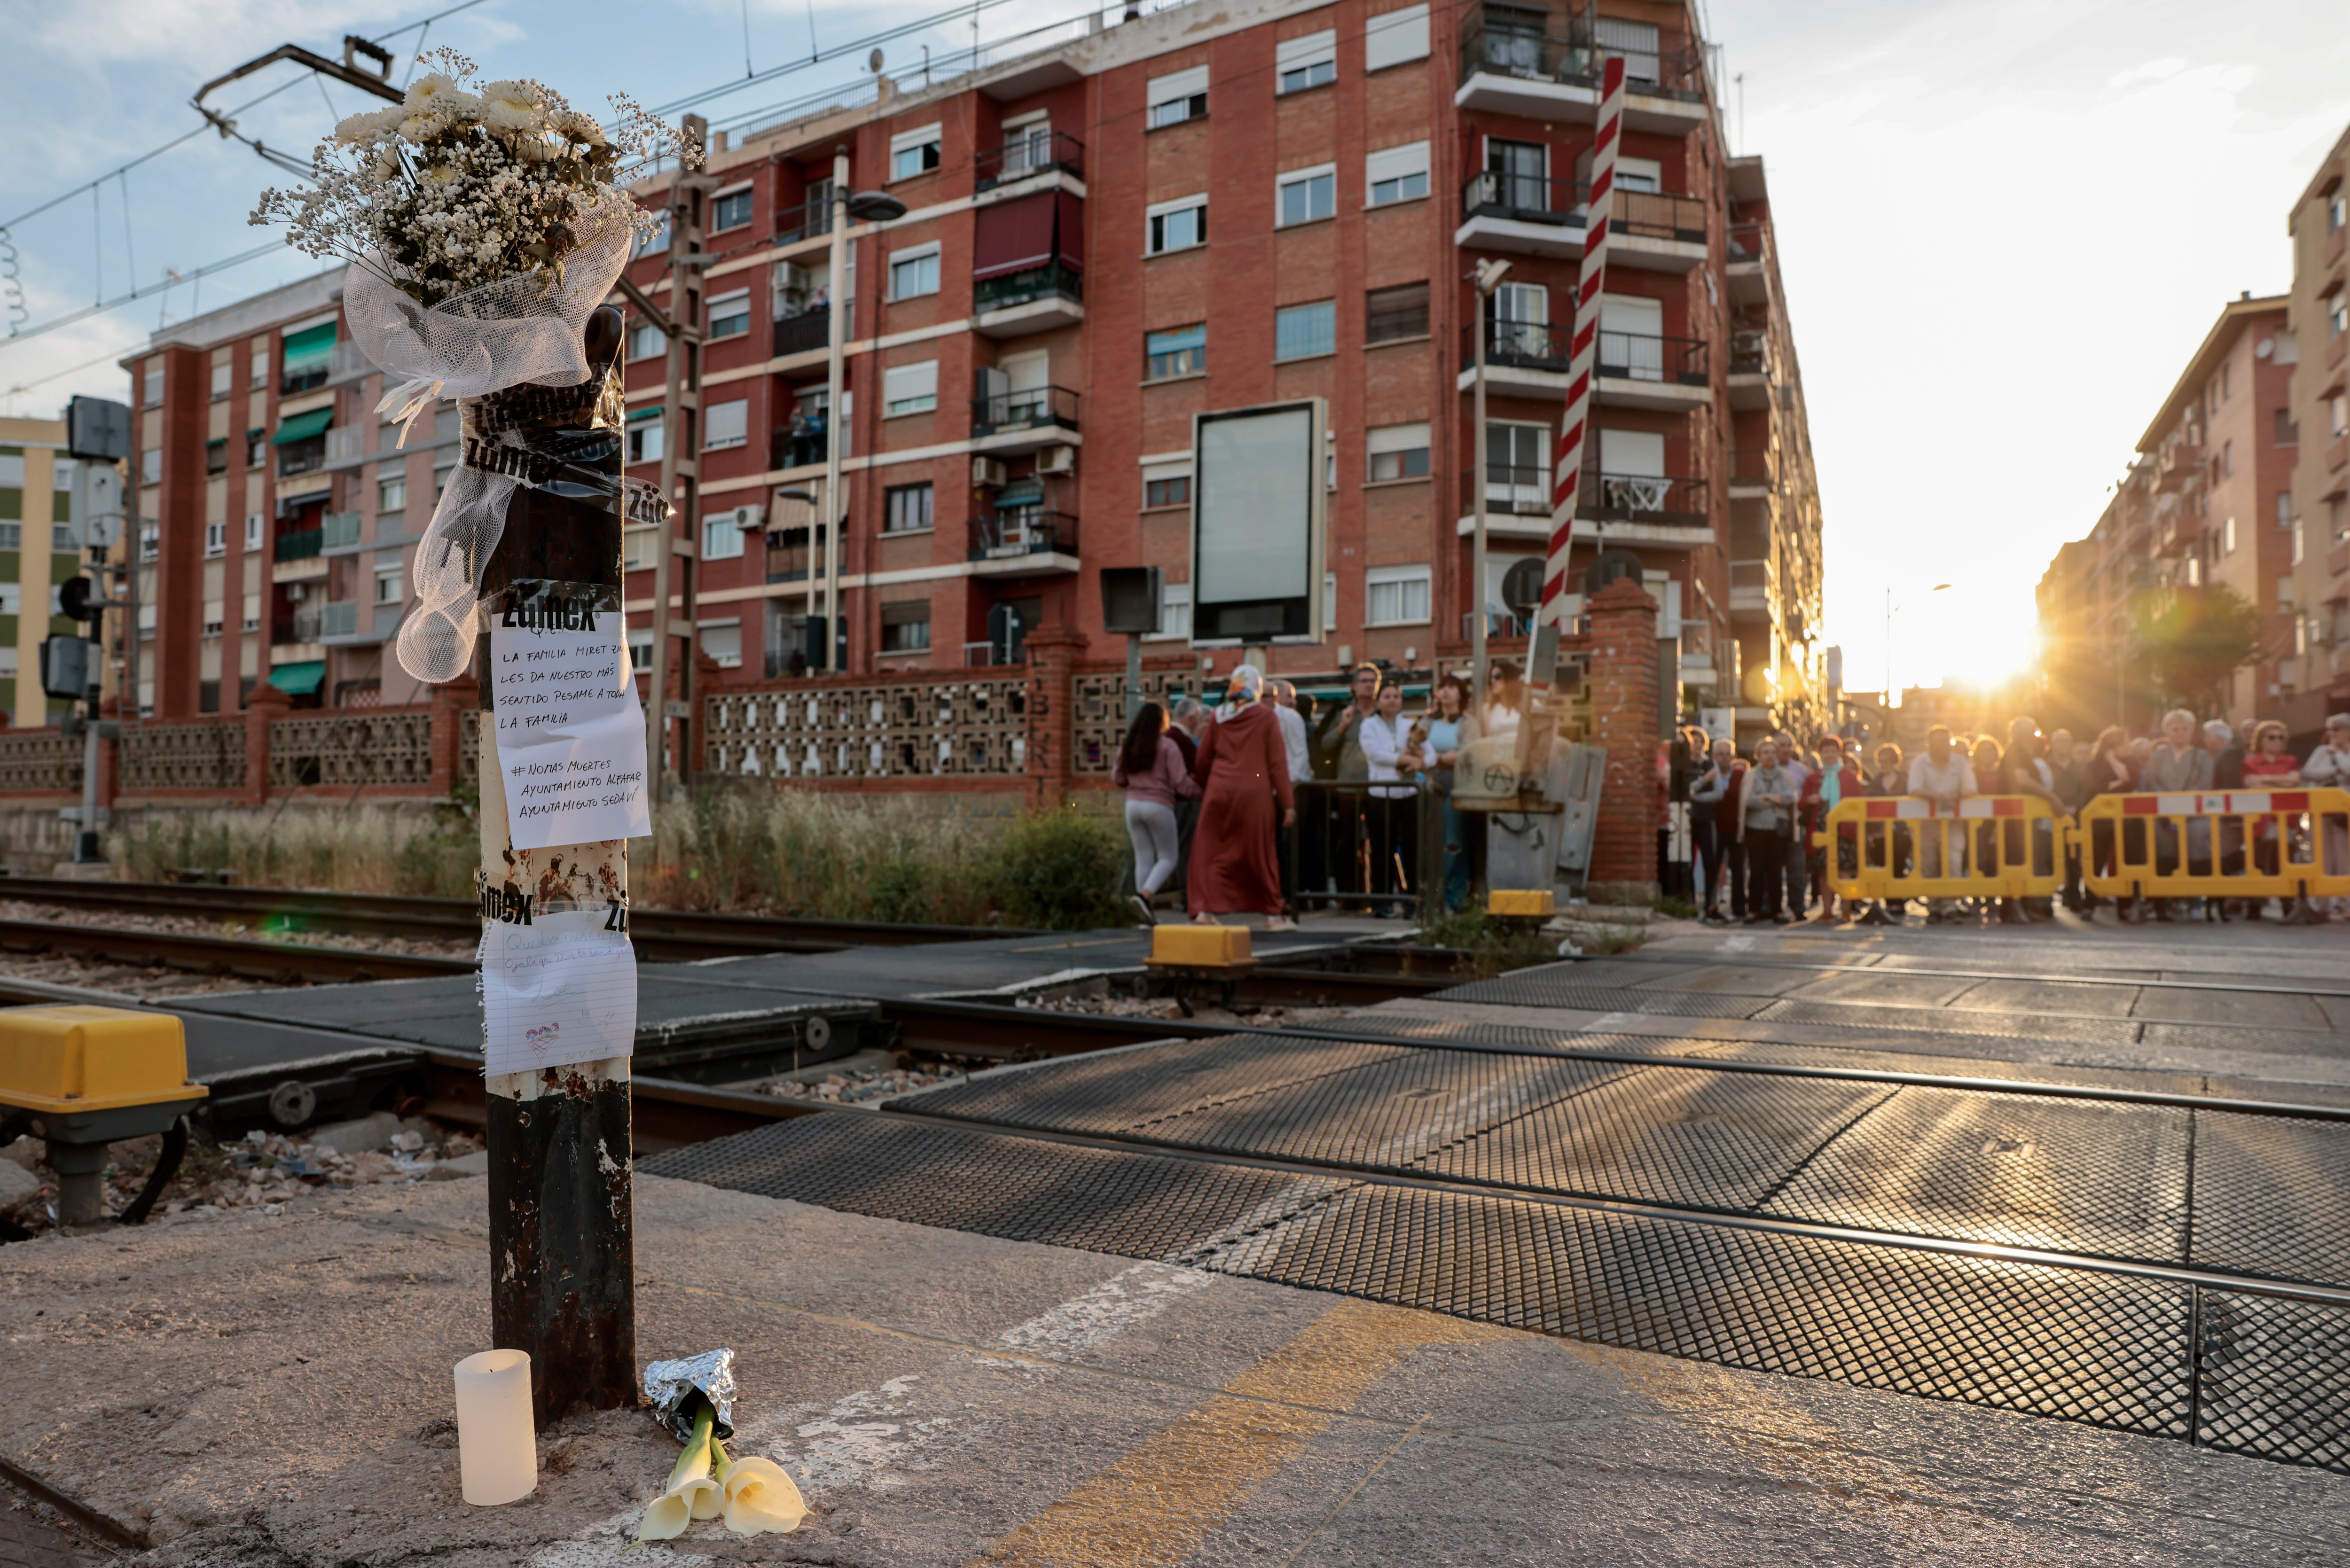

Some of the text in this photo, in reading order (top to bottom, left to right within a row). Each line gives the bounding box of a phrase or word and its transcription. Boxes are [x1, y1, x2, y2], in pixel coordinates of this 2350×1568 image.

[503, 652, 519, 663] LA
[526, 649, 566, 662] FAMILIA
[576, 645, 608, 656] MIRET
[501, 673, 524, 683] LES
[530, 671, 545, 683] DA
[549, 670, 592, 681] NUESTRO
[499, 688, 625, 706] SENTIDO PESAME A TODA
[500, 717, 518, 729] LA
[567, 760, 611, 773] MUERTES
[521, 771, 642, 797] AYUNTAMIENTO ALFAFAR
[519, 785, 639, 818] AYUNTAMIENTO SEDAVÍ
[506, 934, 534, 950] Que
[539, 958, 553, 968] que
[555, 953, 575, 962] Dios
[578, 948, 586, 957] te
